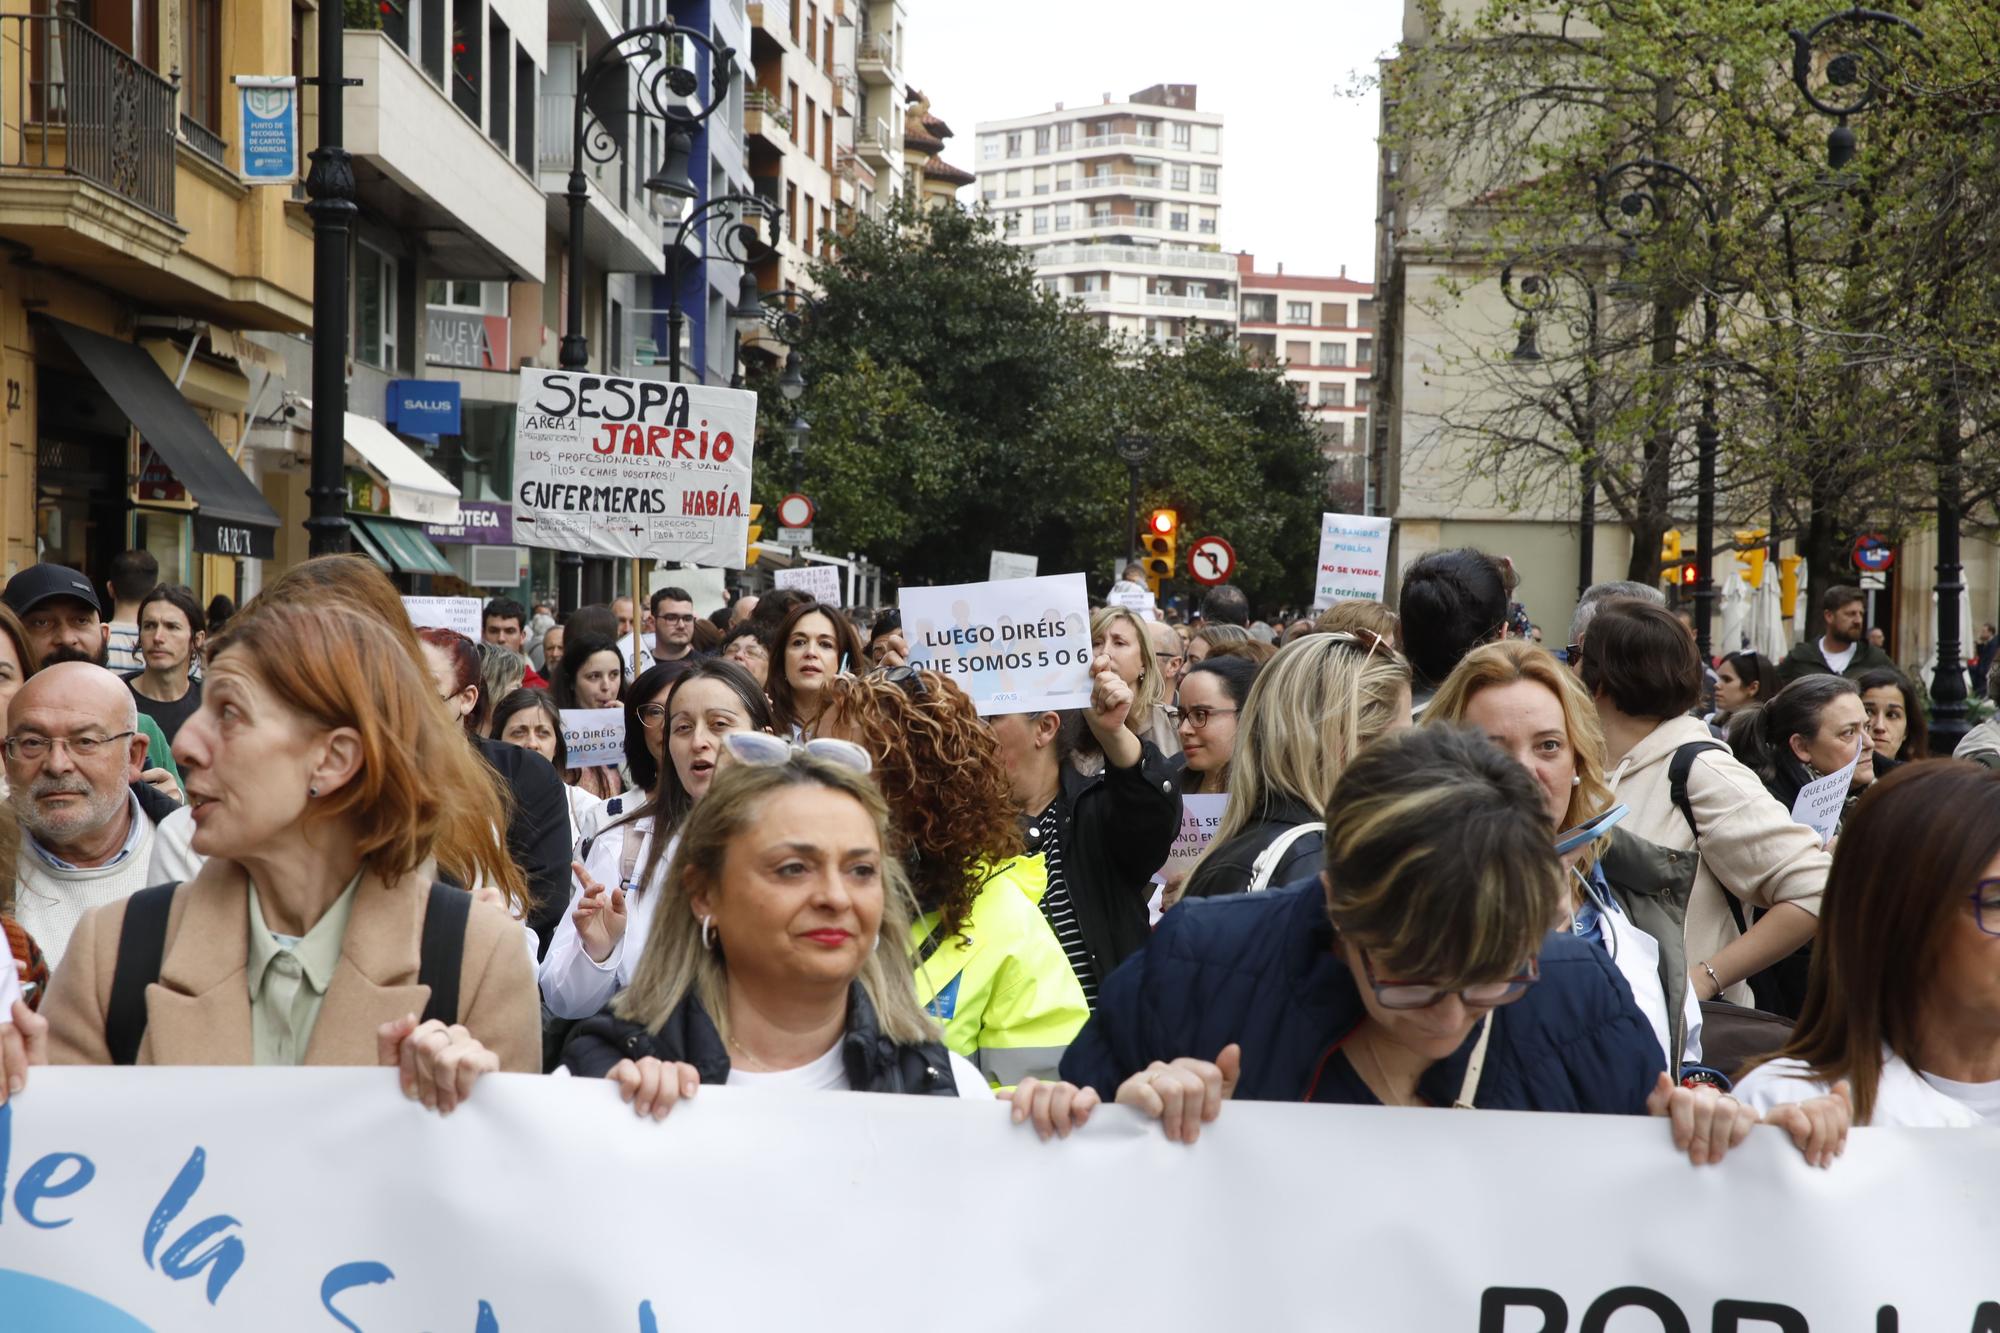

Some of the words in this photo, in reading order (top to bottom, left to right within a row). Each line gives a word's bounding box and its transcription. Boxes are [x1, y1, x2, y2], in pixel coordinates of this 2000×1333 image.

[404, 400, 452, 411] SALUS
[535, 375, 690, 428] SESPA
[526, 415, 566, 430] AREA
[568, 418, 576, 431] 1
[529, 450, 551, 463] LOS
[658, 460, 671, 468] NO
[680, 461, 693, 470] SE
[580, 466, 618, 477] ECHAIS
[520, 480, 666, 514] ENFERMERAS
[458, 509, 499, 527] OTECA
[653, 520, 697, 528] DERECHOS
[428, 525, 466, 536] GOUMET
[654, 531, 674, 540] PARA
[678, 531, 709, 540] TODOS
[1321, 564, 1334, 572] NO
[1337, 566, 1348, 574] SE
[1322, 586, 1333, 594] SE
[925, 626, 995, 647] LUEGO
[1001, 618, 1066, 641] DIRÉIS
[958, 652, 1032, 674] SOMOS
[1038, 651, 1049, 667] 5
[1055, 649, 1071, 666] O
[1077, 648, 1089, 665] 6
[564, 731, 580, 740] GO
[583, 728, 616, 739] DIRÉIS
[566, 743, 597, 753] OMOS
[600, 742, 606, 750] 5
[609, 741, 617, 749] O
[1803, 786, 1820, 799] QUE
[1822, 778, 1837, 791] LOS
[1189, 818, 1202, 827] EL
[143, 1145, 245, 1306] la
